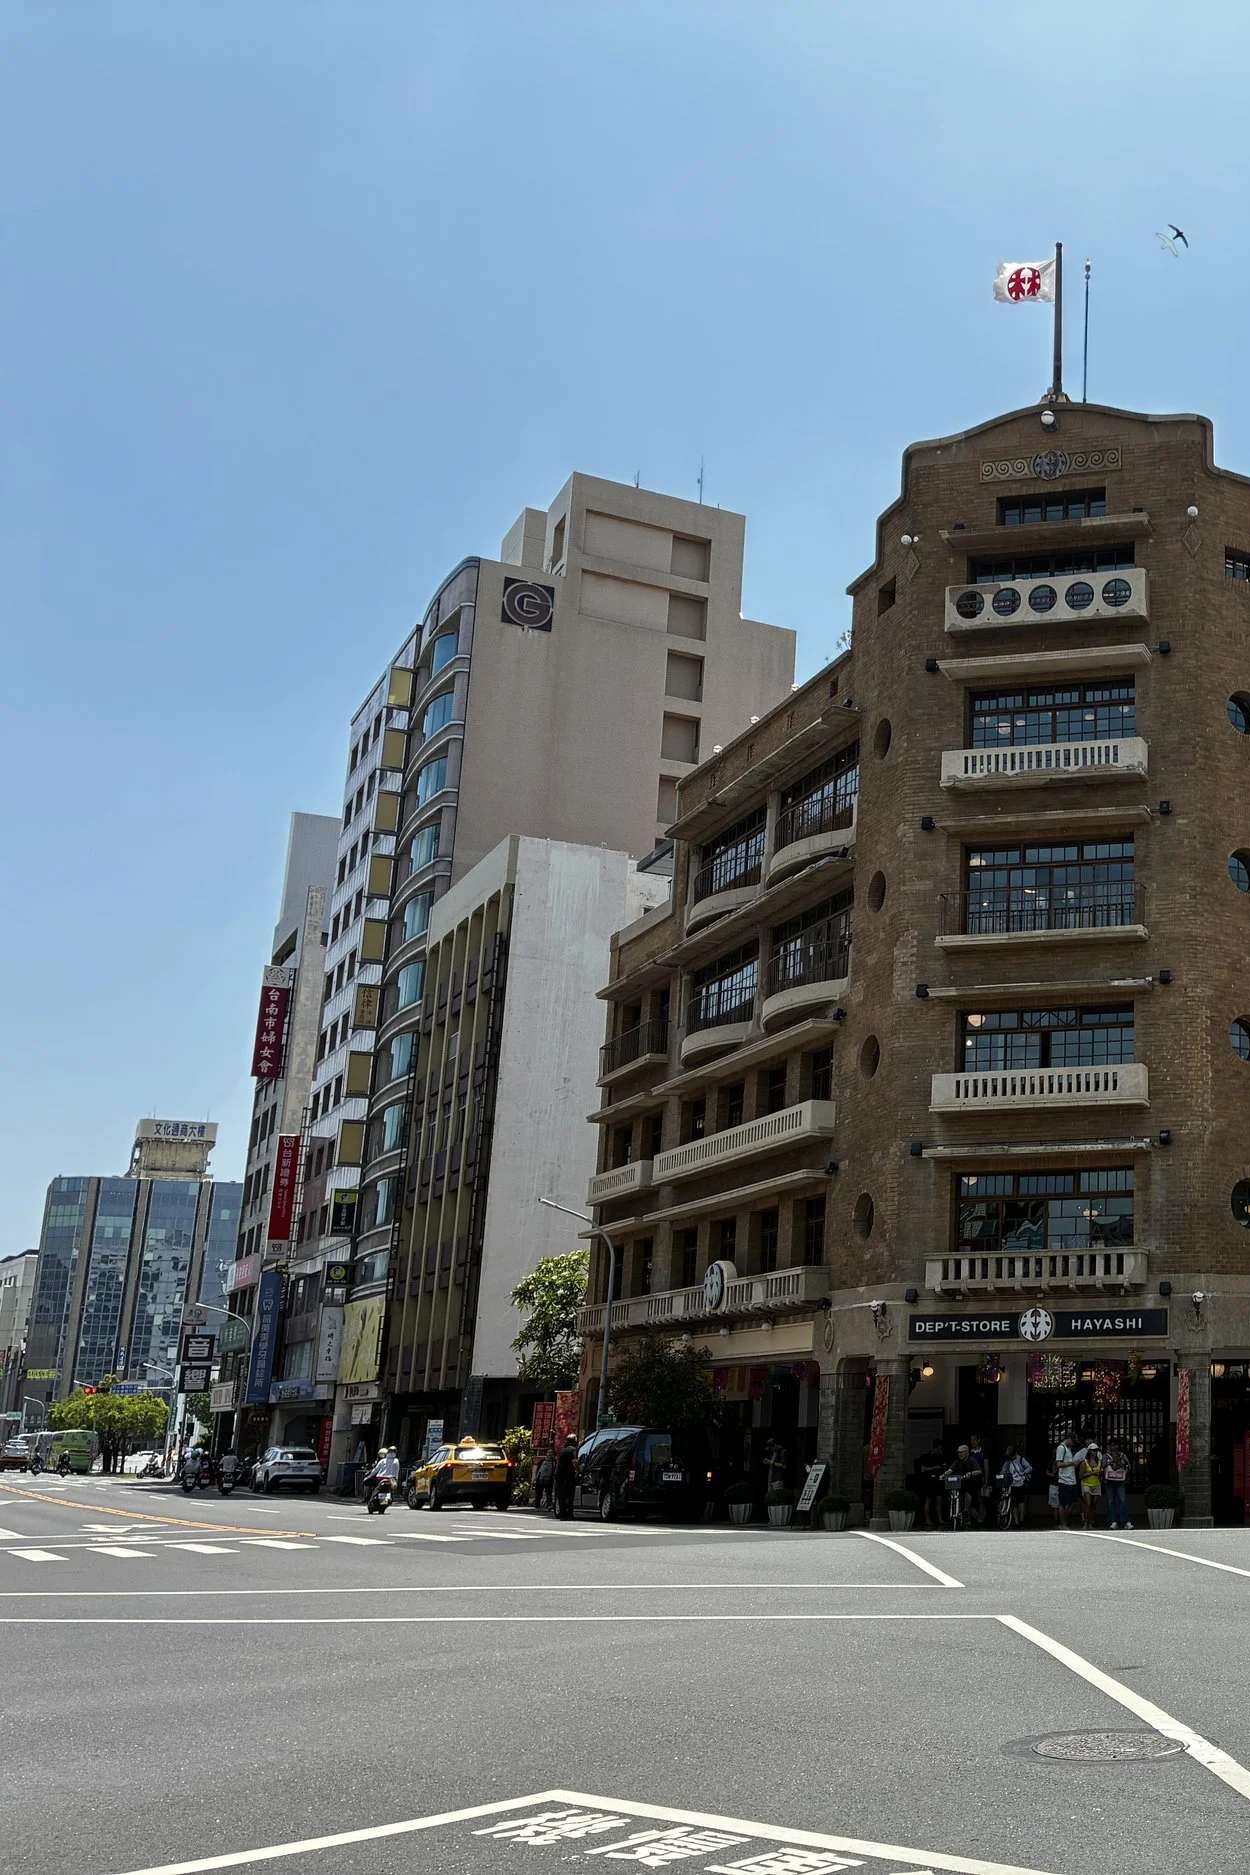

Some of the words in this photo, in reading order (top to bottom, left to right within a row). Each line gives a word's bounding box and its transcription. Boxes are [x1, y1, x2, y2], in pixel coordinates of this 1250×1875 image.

[258, 989, 280, 1073] 台南市婦女會
[915, 1319, 1011, 1334] DEP'T-STORE
[1070, 1317, 1143, 1330] HAYASHI
[183, 1337, 211, 1390] 音響
